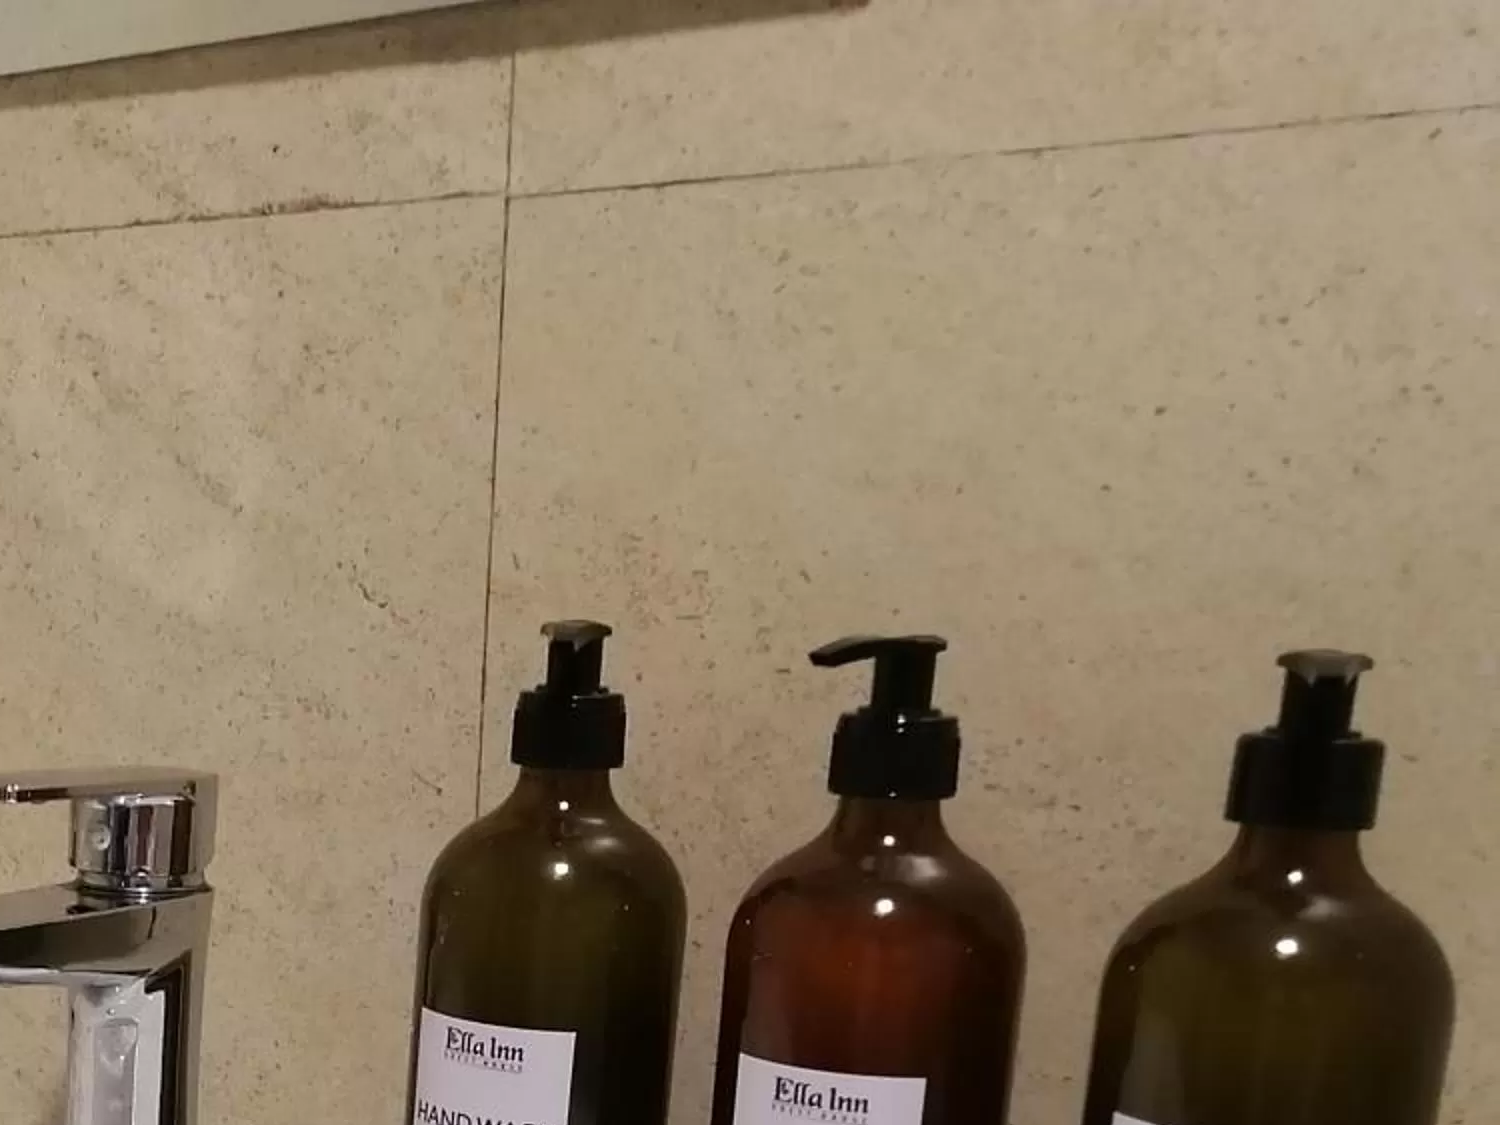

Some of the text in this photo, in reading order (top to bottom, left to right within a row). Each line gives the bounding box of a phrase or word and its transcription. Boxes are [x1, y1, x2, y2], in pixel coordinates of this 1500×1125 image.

[446, 1026, 485, 1057] Ella
[490, 1036, 524, 1063] Inn
[774, 1076, 869, 1114] Ella Inn
